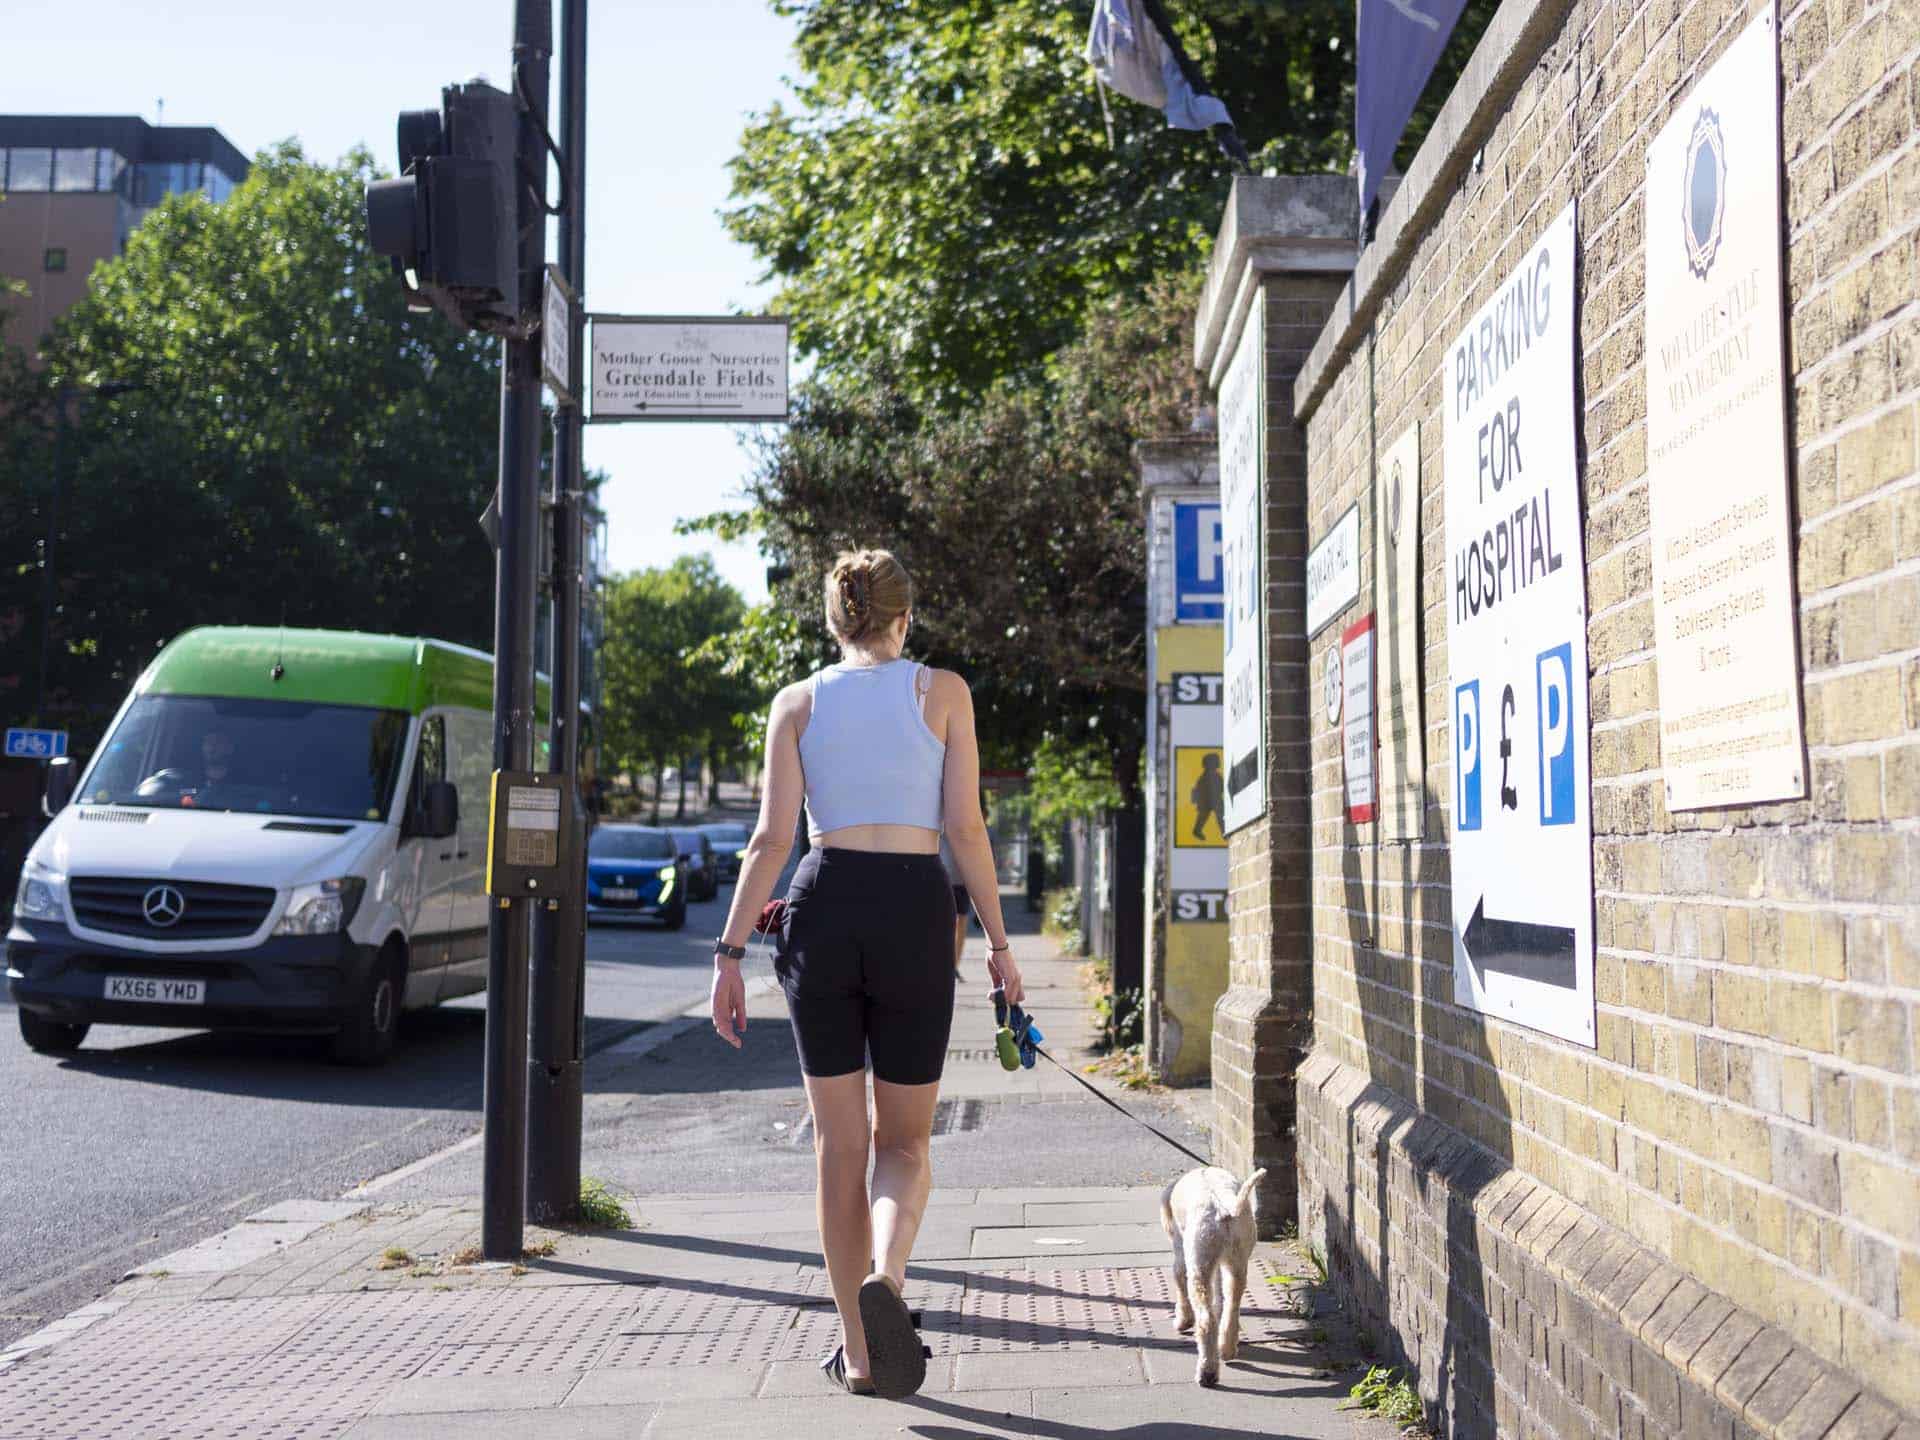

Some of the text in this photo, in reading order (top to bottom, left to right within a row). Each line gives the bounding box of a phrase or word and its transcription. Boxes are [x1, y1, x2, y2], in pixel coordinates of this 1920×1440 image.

[600, 352, 781, 366] Mother Goose Nurseries
[1456, 247, 1551, 422] PARKING
[605, 368, 776, 387] Greendale Fields
[1478, 395, 1522, 505] FOR
[1455, 487, 1562, 625] HOSPITAL
[1458, 655, 1569, 825] P £ P
[1177, 891, 1230, 920] ST
[112, 979, 198, 1000] KX66 YMD
